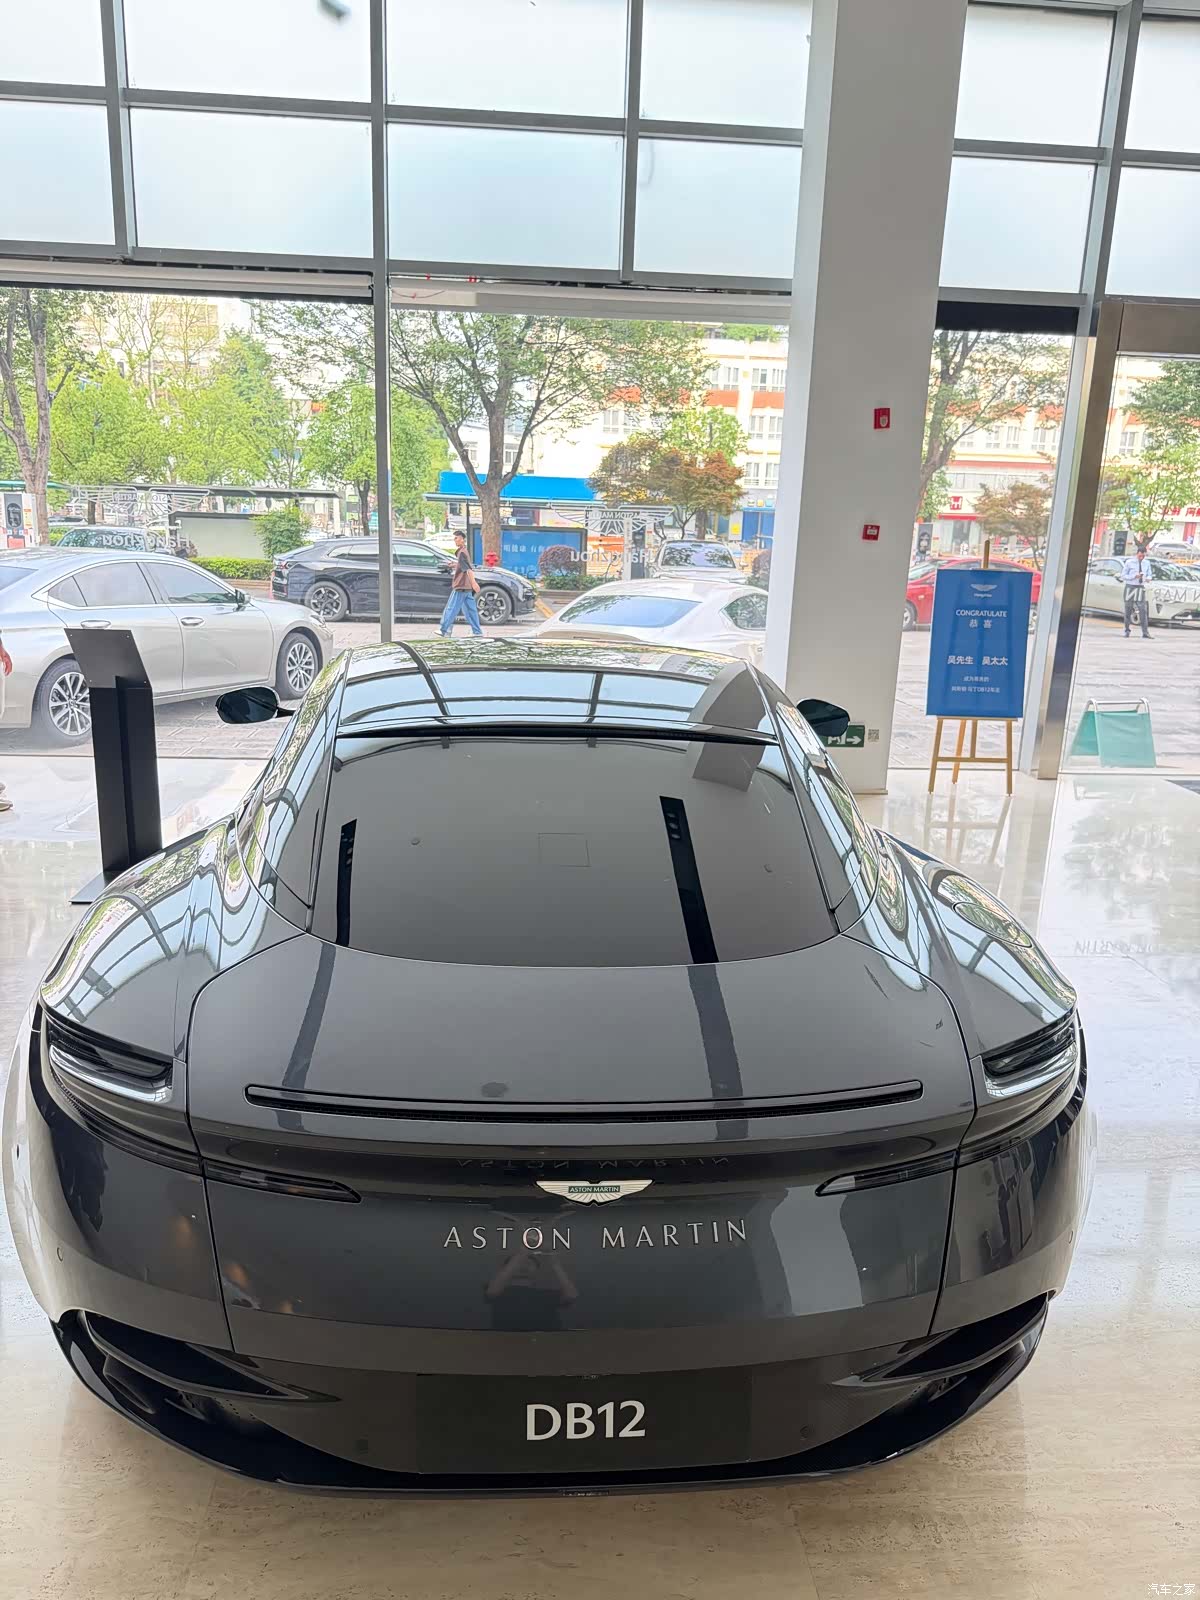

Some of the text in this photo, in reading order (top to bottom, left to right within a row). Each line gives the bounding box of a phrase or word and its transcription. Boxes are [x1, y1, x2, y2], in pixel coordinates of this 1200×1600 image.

[955, 609, 1008, 618] CONGRATULATE
[947, 655, 1009, 666] 吴先生 吴太太
[443, 1219, 747, 1250] ASTON MARTIN
[526, 1400, 646, 1441] DB12
